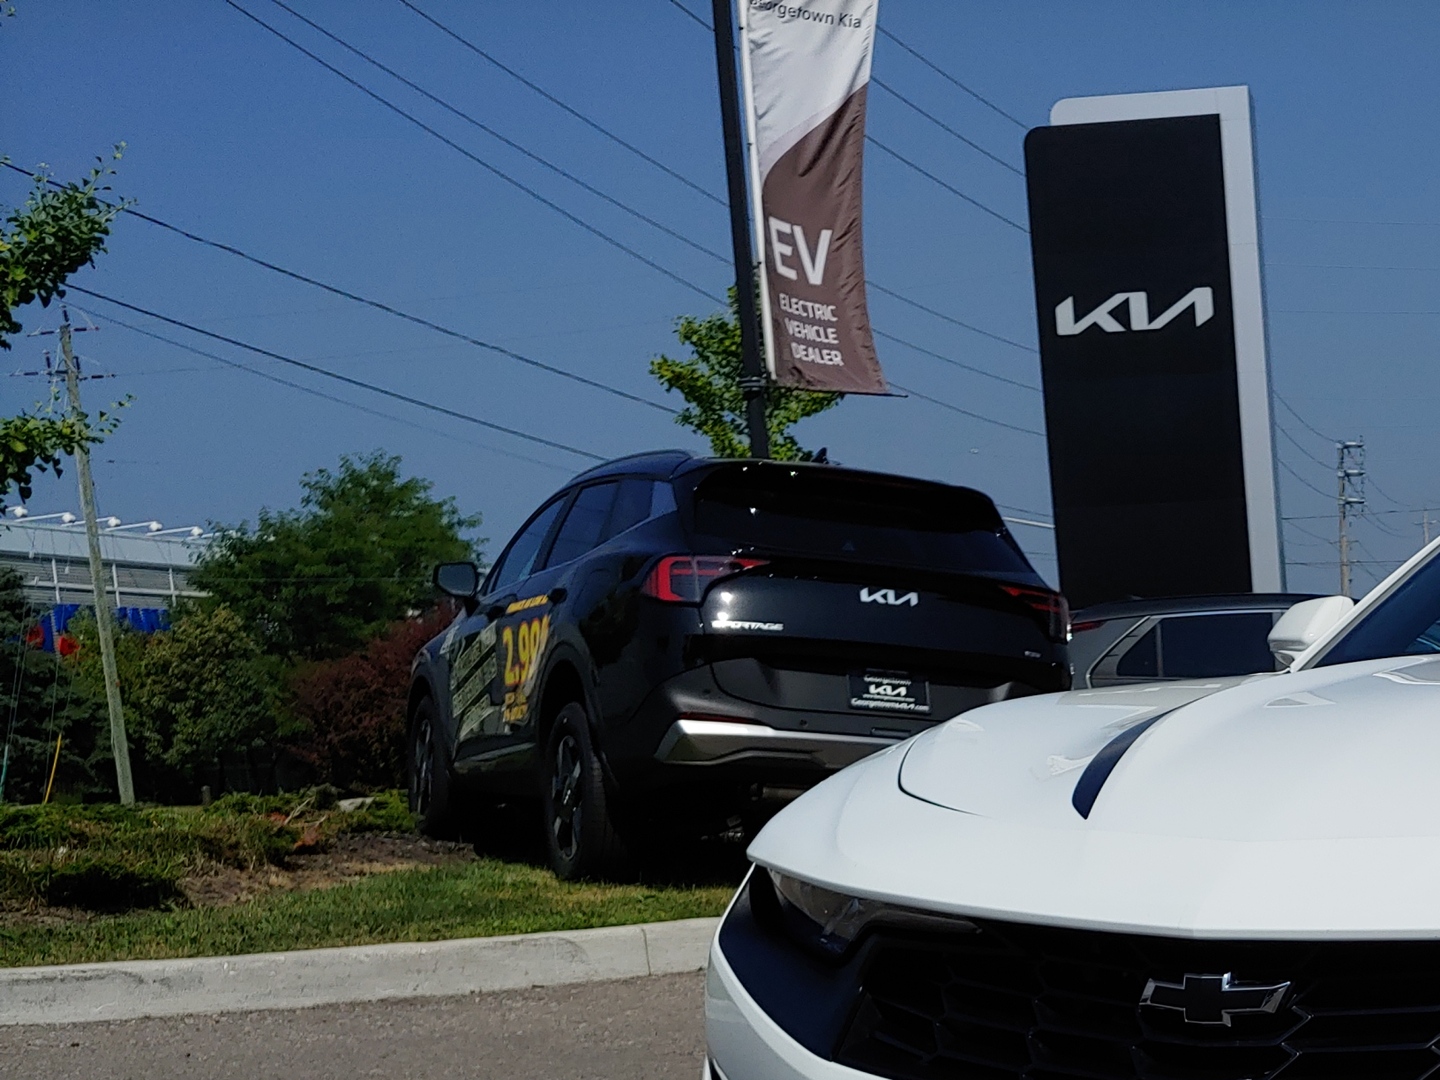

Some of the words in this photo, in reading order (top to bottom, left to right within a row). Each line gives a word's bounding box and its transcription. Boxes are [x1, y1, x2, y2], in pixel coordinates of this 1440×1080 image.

[838, 12, 861, 29] Kia
[768, 216, 833, 286] EV
[780, 292, 838, 322] ELECTRIC
[1055, 286, 1214, 336] KIA
[784, 319, 839, 345] VEHICLE
[791, 342, 844, 367] DEALER
[859, 587, 919, 607] KIA
[868, 684, 907, 697] KIA
